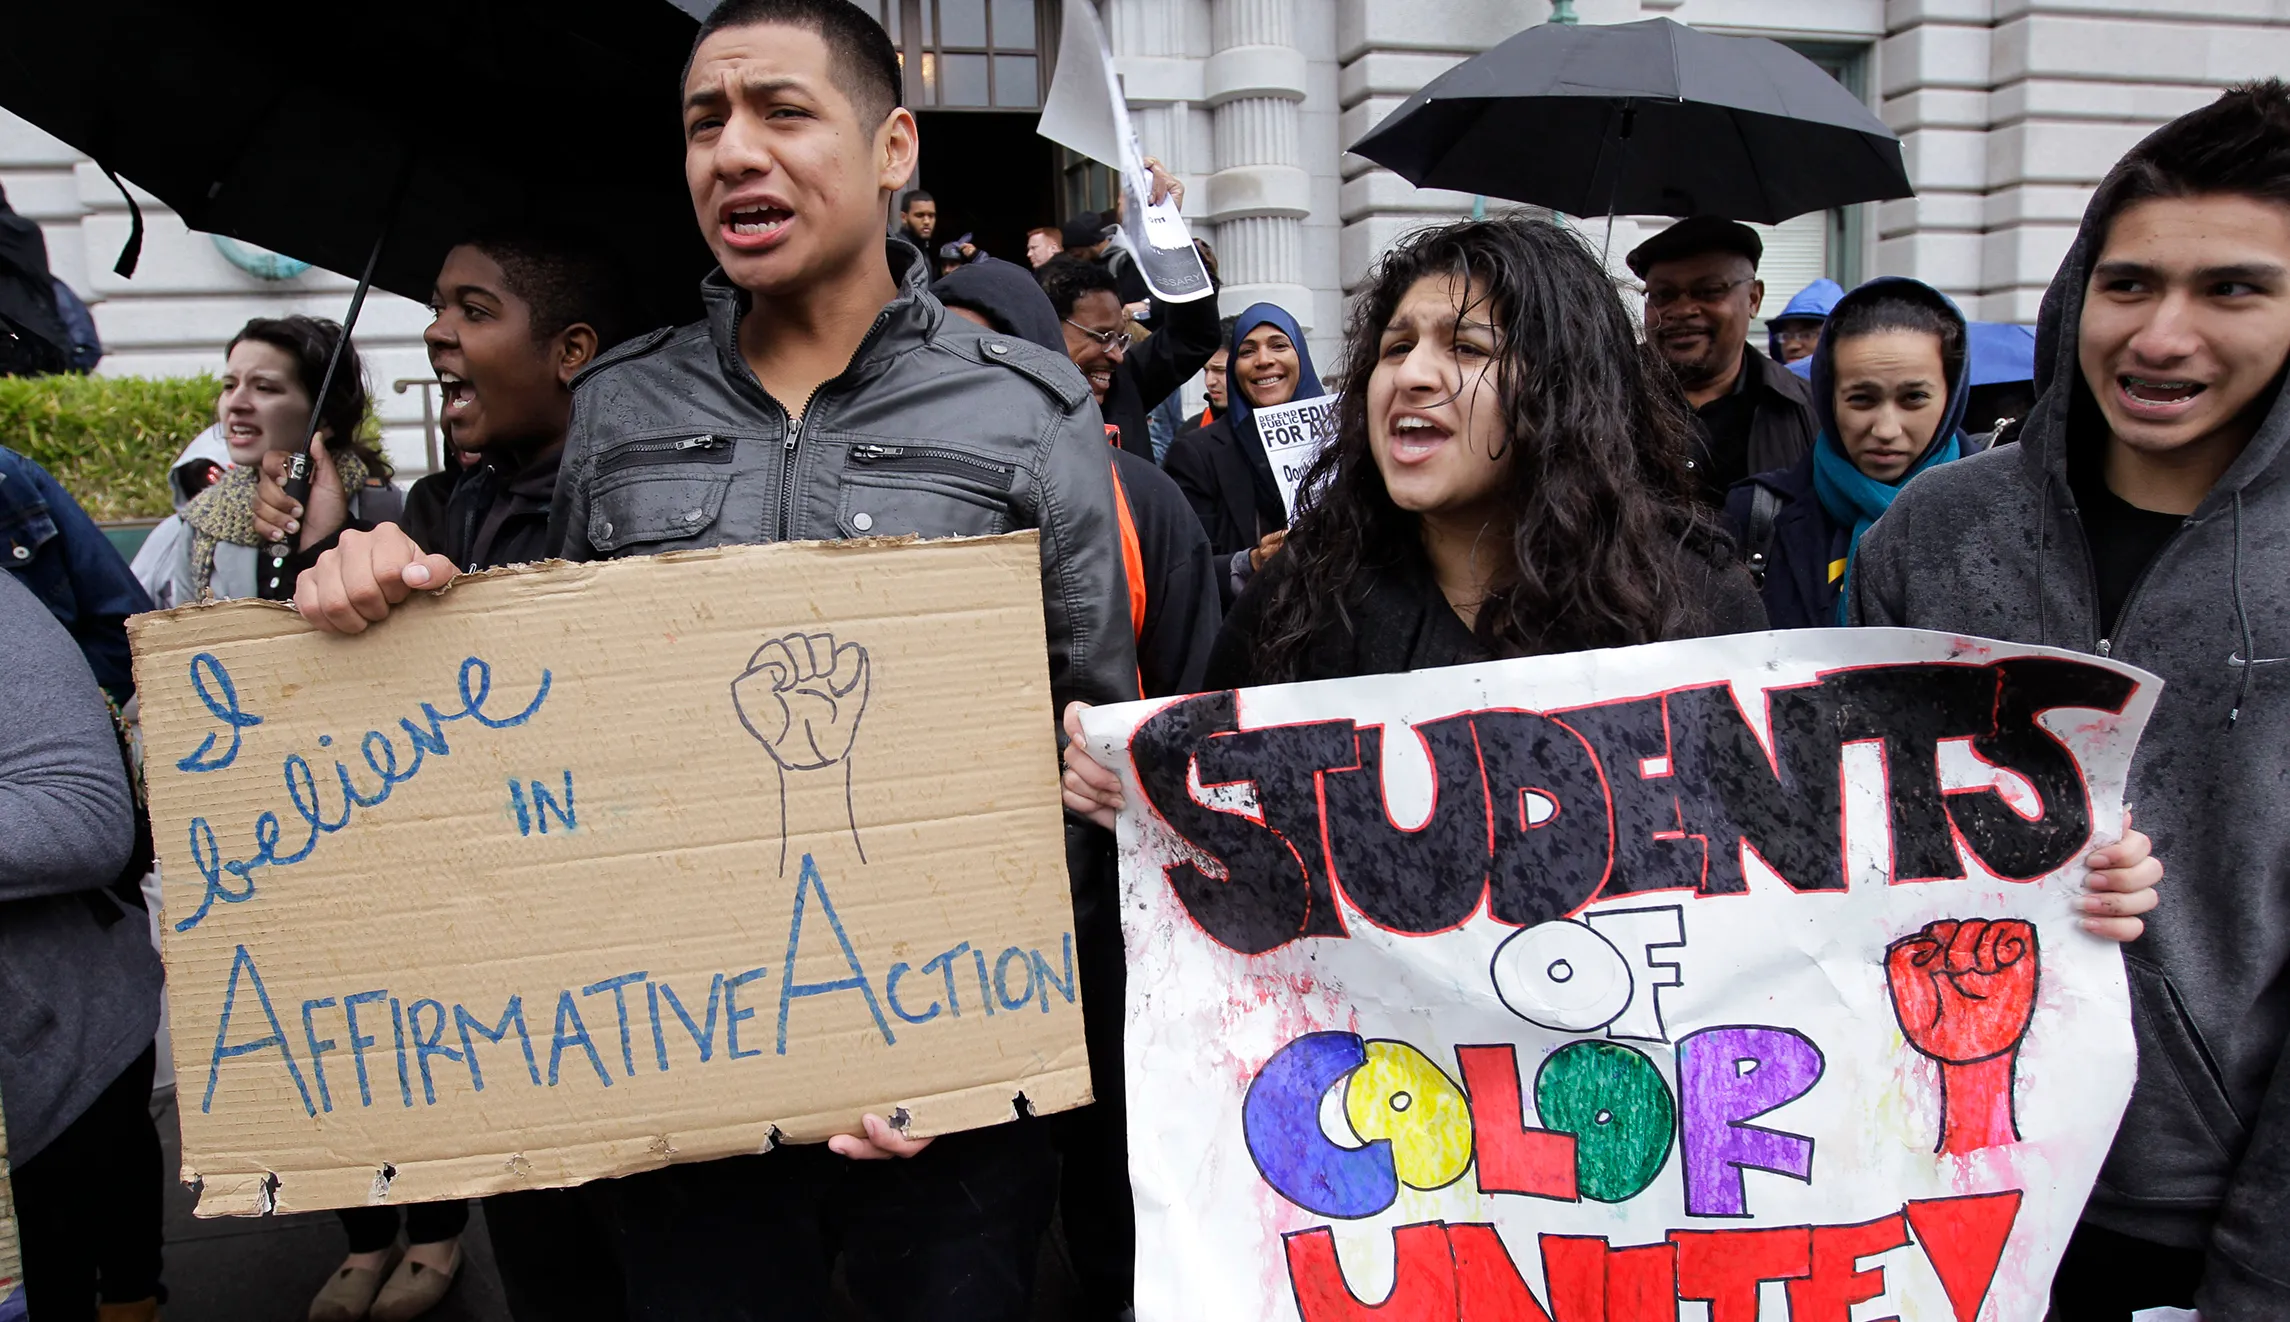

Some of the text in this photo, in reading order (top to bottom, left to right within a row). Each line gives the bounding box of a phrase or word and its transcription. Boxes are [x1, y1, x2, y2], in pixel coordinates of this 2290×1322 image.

[1155, 272, 1202, 287] ESSARY
[1258, 409, 1298, 423] DEFEND
[1260, 403, 1334, 430] PUBLIC EDU
[1263, 424, 1305, 448] FOR
[176, 652, 264, 774] I
[174, 656, 553, 935] believe
[507, 768, 579, 838] IN
[1129, 656, 2140, 956] STUDENTS
[201, 852, 1078, 1119] AFFIRMATIVE ACTION
[1491, 905, 1687, 1044] OF
[1242, 1024, 1825, 1220] COLOR
